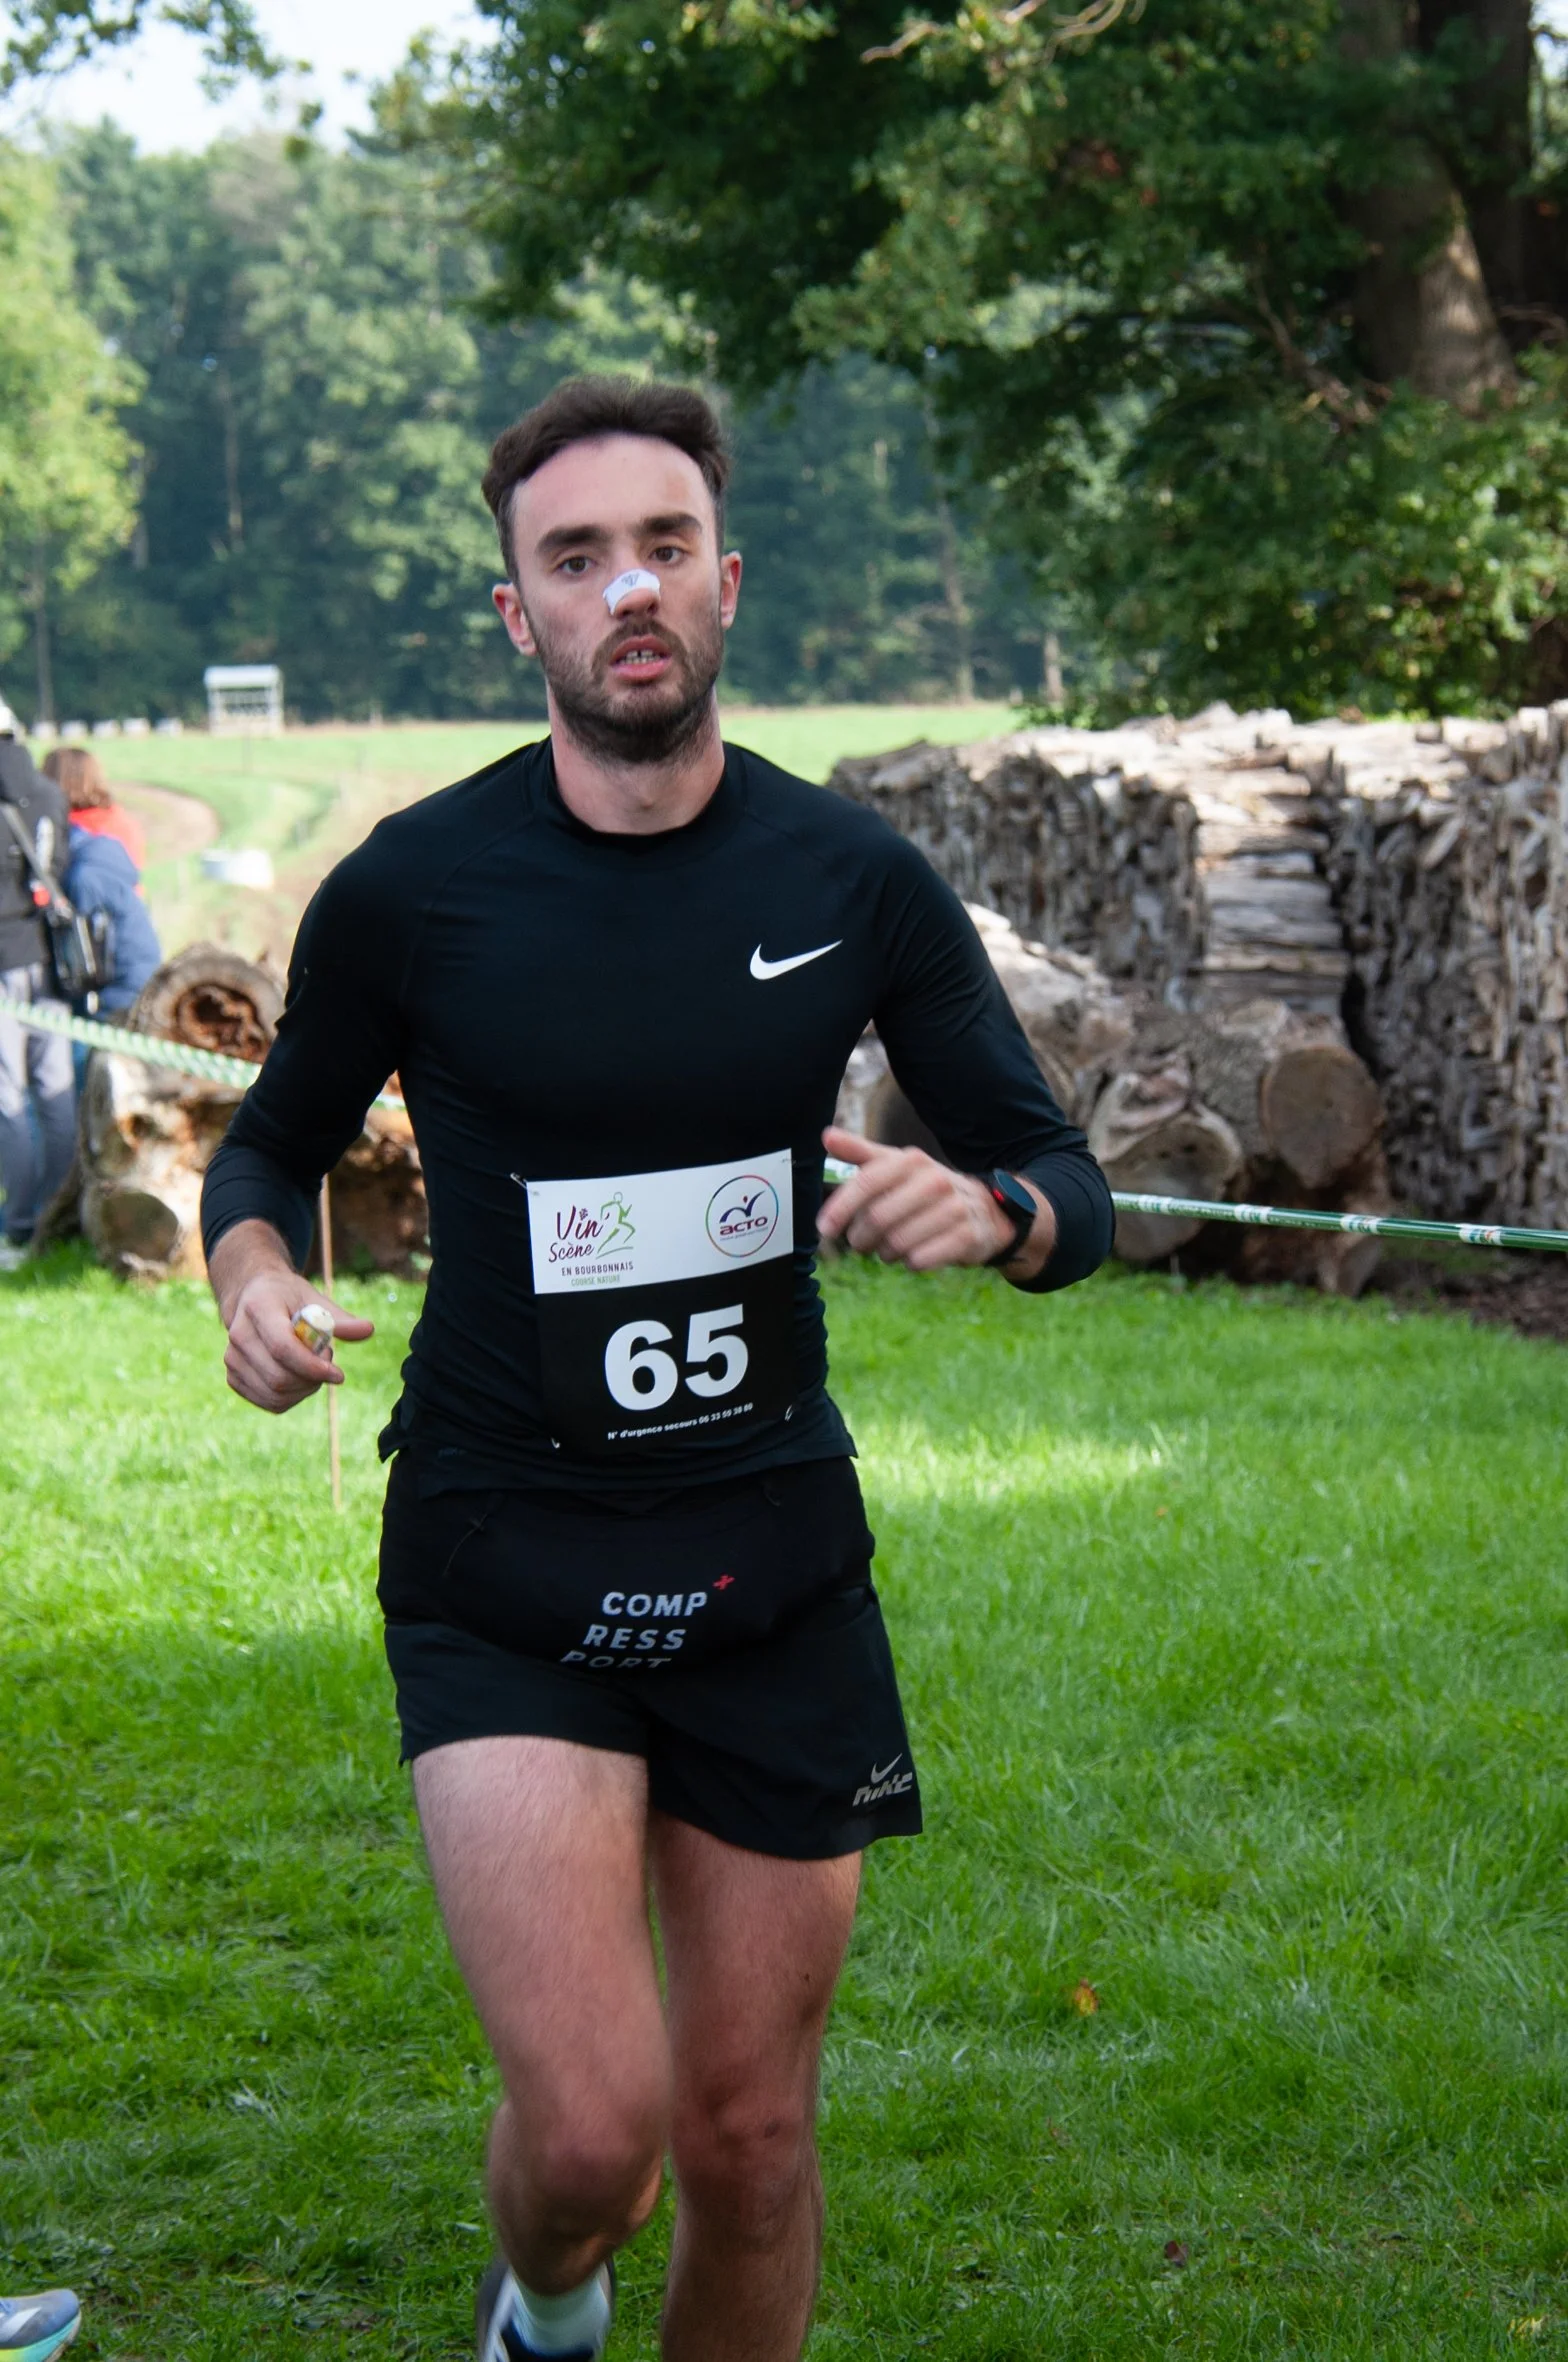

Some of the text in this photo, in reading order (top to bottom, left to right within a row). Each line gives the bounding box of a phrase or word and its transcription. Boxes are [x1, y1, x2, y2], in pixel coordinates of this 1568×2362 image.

[548, 1242, 595, 1263] Scène
[562, 1261, 634, 1276] EN BOURBONNAIS
[604, 1303, 749, 1411] 65
[620, 1424, 663, 1438] d'urgence
[664, 1419, 698, 1431] secours
[602, 1591, 708, 1617] COMP
[582, 1623, 687, 1650] RESS
[560, 1650, 672, 1669] PORT
